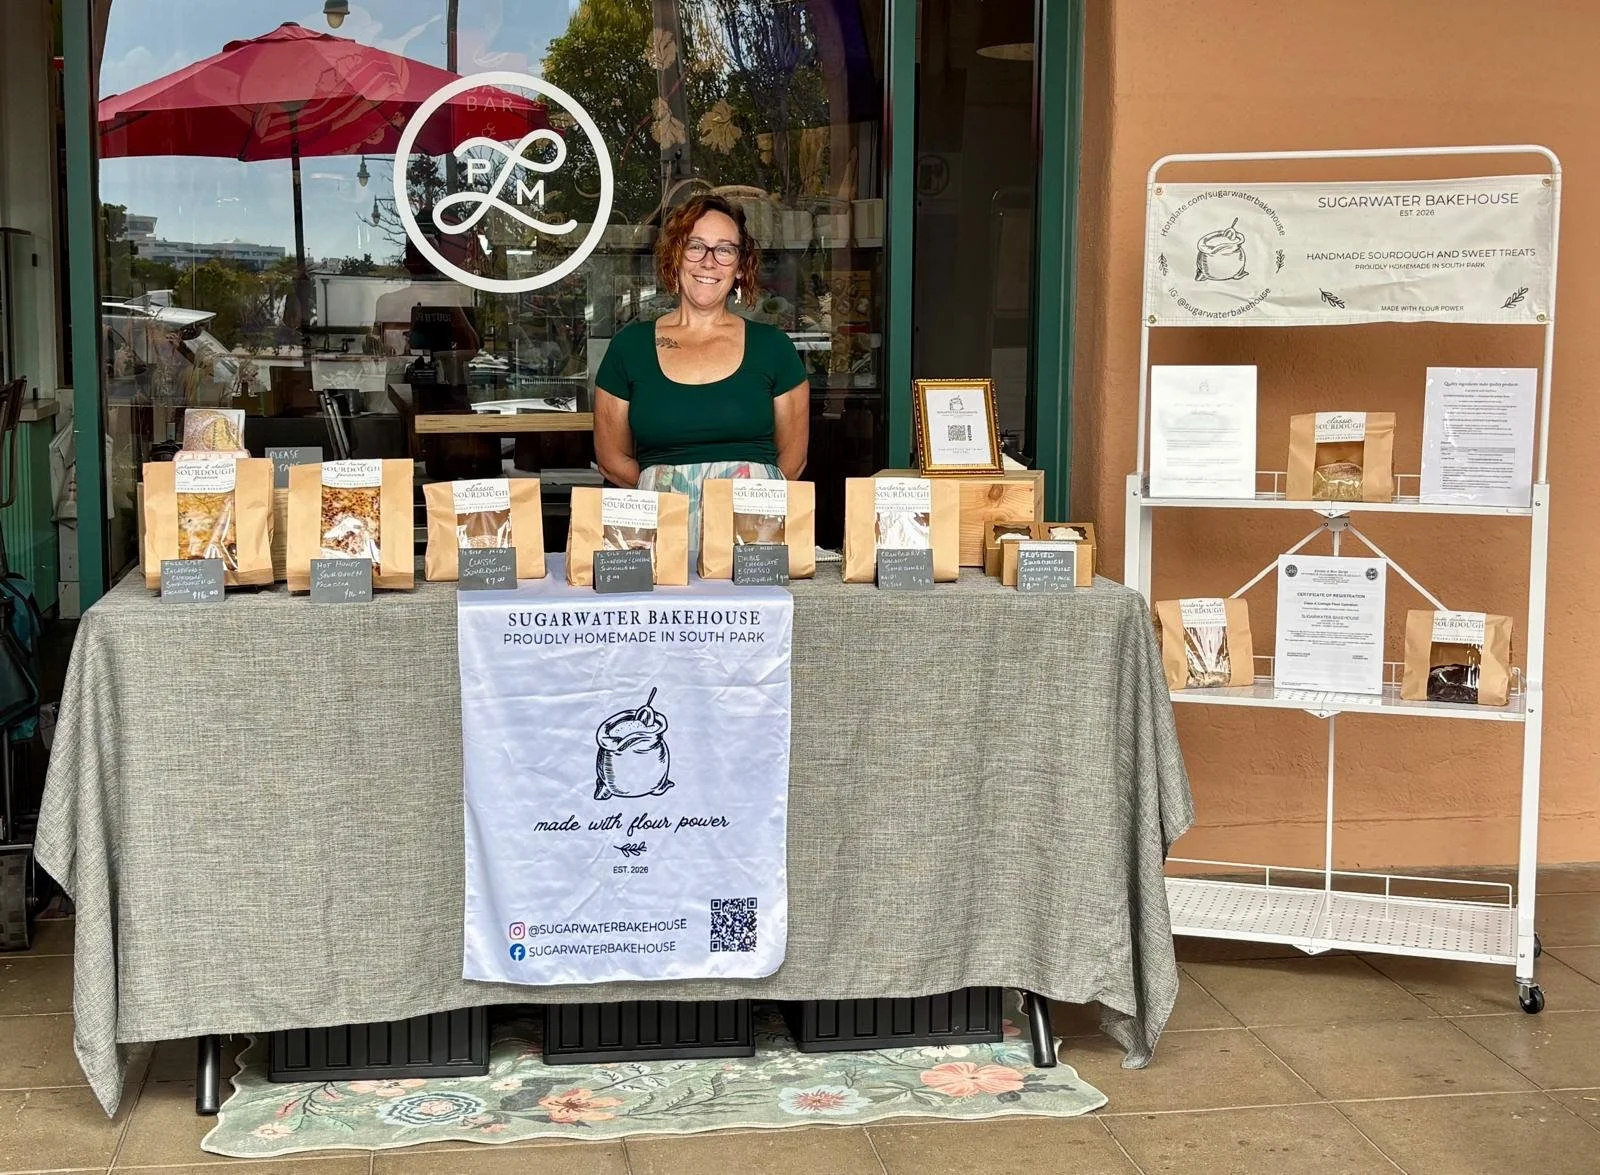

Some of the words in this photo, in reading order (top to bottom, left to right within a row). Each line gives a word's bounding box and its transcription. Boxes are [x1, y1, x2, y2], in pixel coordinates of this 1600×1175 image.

[466, 97, 513, 112] BAR
[1318, 195, 1421, 208] SUGARWATER
[1426, 193, 1519, 206] BAKEHOUSE
[1161, 190, 1285, 237] Hotplate.com/sugarwaterbakehouse
[1307, 252, 1366, 260] HANDMADE
[1368, 250, 1434, 259] SOURDOUGH
[1437, 250, 1459, 258] AND
[1462, 249, 1496, 258] SWEET
[1500, 248, 1536, 257] TREATS
[1177, 288, 1271, 319] @sugarwaterbakehouse
[269, 450, 299, 458] PLEASE
[454, 490, 508, 499] SOURDOUGH
[603, 501, 656, 511] SOURDOUGH
[508, 610, 642, 627] SUGARWATER
[647, 610, 762, 626] BAKEHOUSE
[1434, 621, 1484, 629] SOURDOUGH
[503, 632, 570, 646] PROUDLY
[573, 631, 657, 644] HOMEMADE
[660, 631, 676, 643] IN
[679, 630, 725, 644] SOUTH
[729, 631, 766, 643] PARK
[533, 814, 581, 832] made
[588, 812, 623, 832] with
[626, 813, 672, 837] flour
[674, 815, 731, 837] power
[612, 866, 629, 875] EST.
[630, 865, 649, 874] 2026
[528, 918, 688, 938] @SUGARWATERBAKEHOUSE
[528, 940, 676, 957] SUGARWATERBAKEHOUSE
